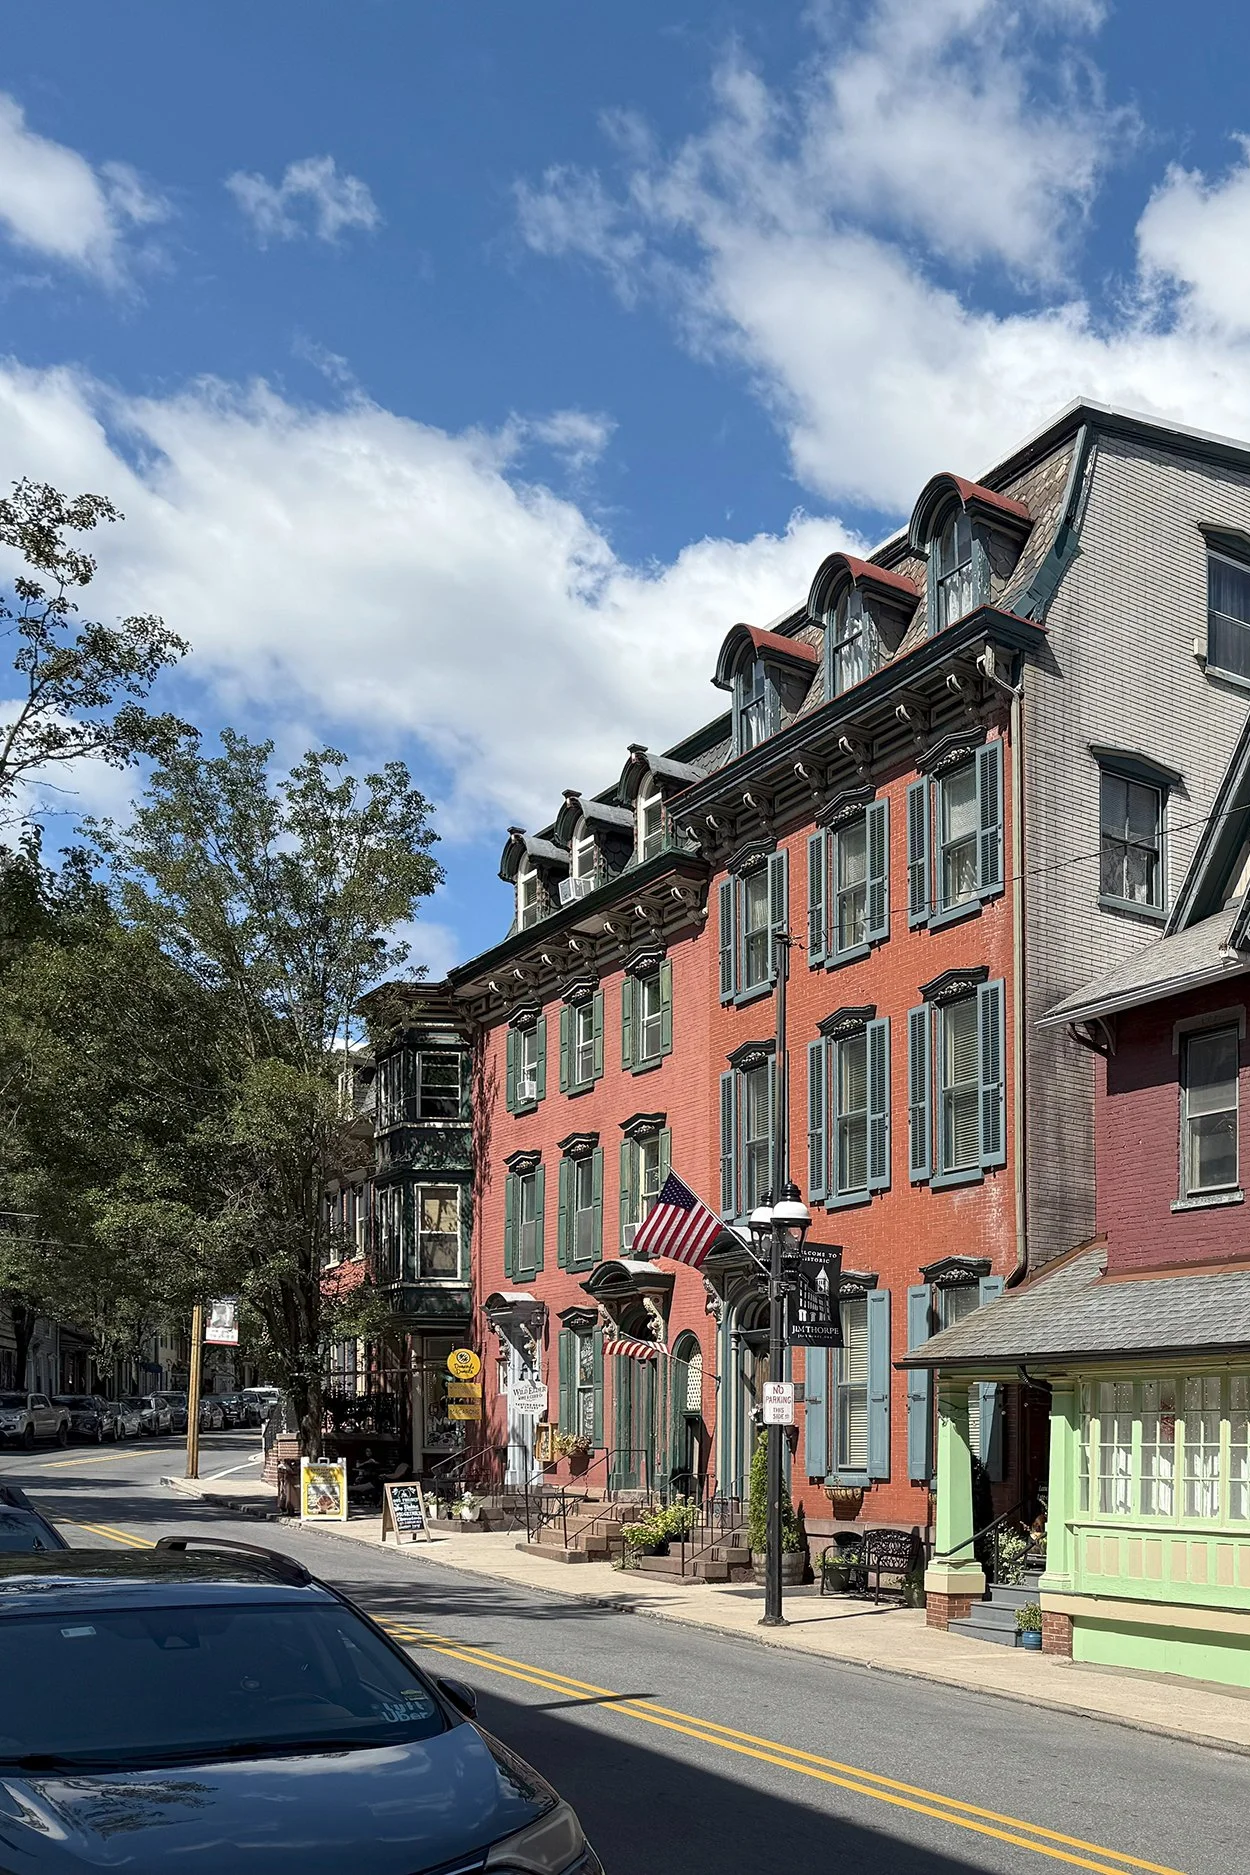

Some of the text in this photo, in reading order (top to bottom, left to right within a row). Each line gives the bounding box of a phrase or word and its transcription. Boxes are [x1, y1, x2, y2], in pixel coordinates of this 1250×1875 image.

[792, 1325, 839, 1334] JIM THORPE
[773, 1386, 784, 1394] NO
[765, 1395, 791, 1405] PARKING
[381, 1710, 428, 1723] Uber
